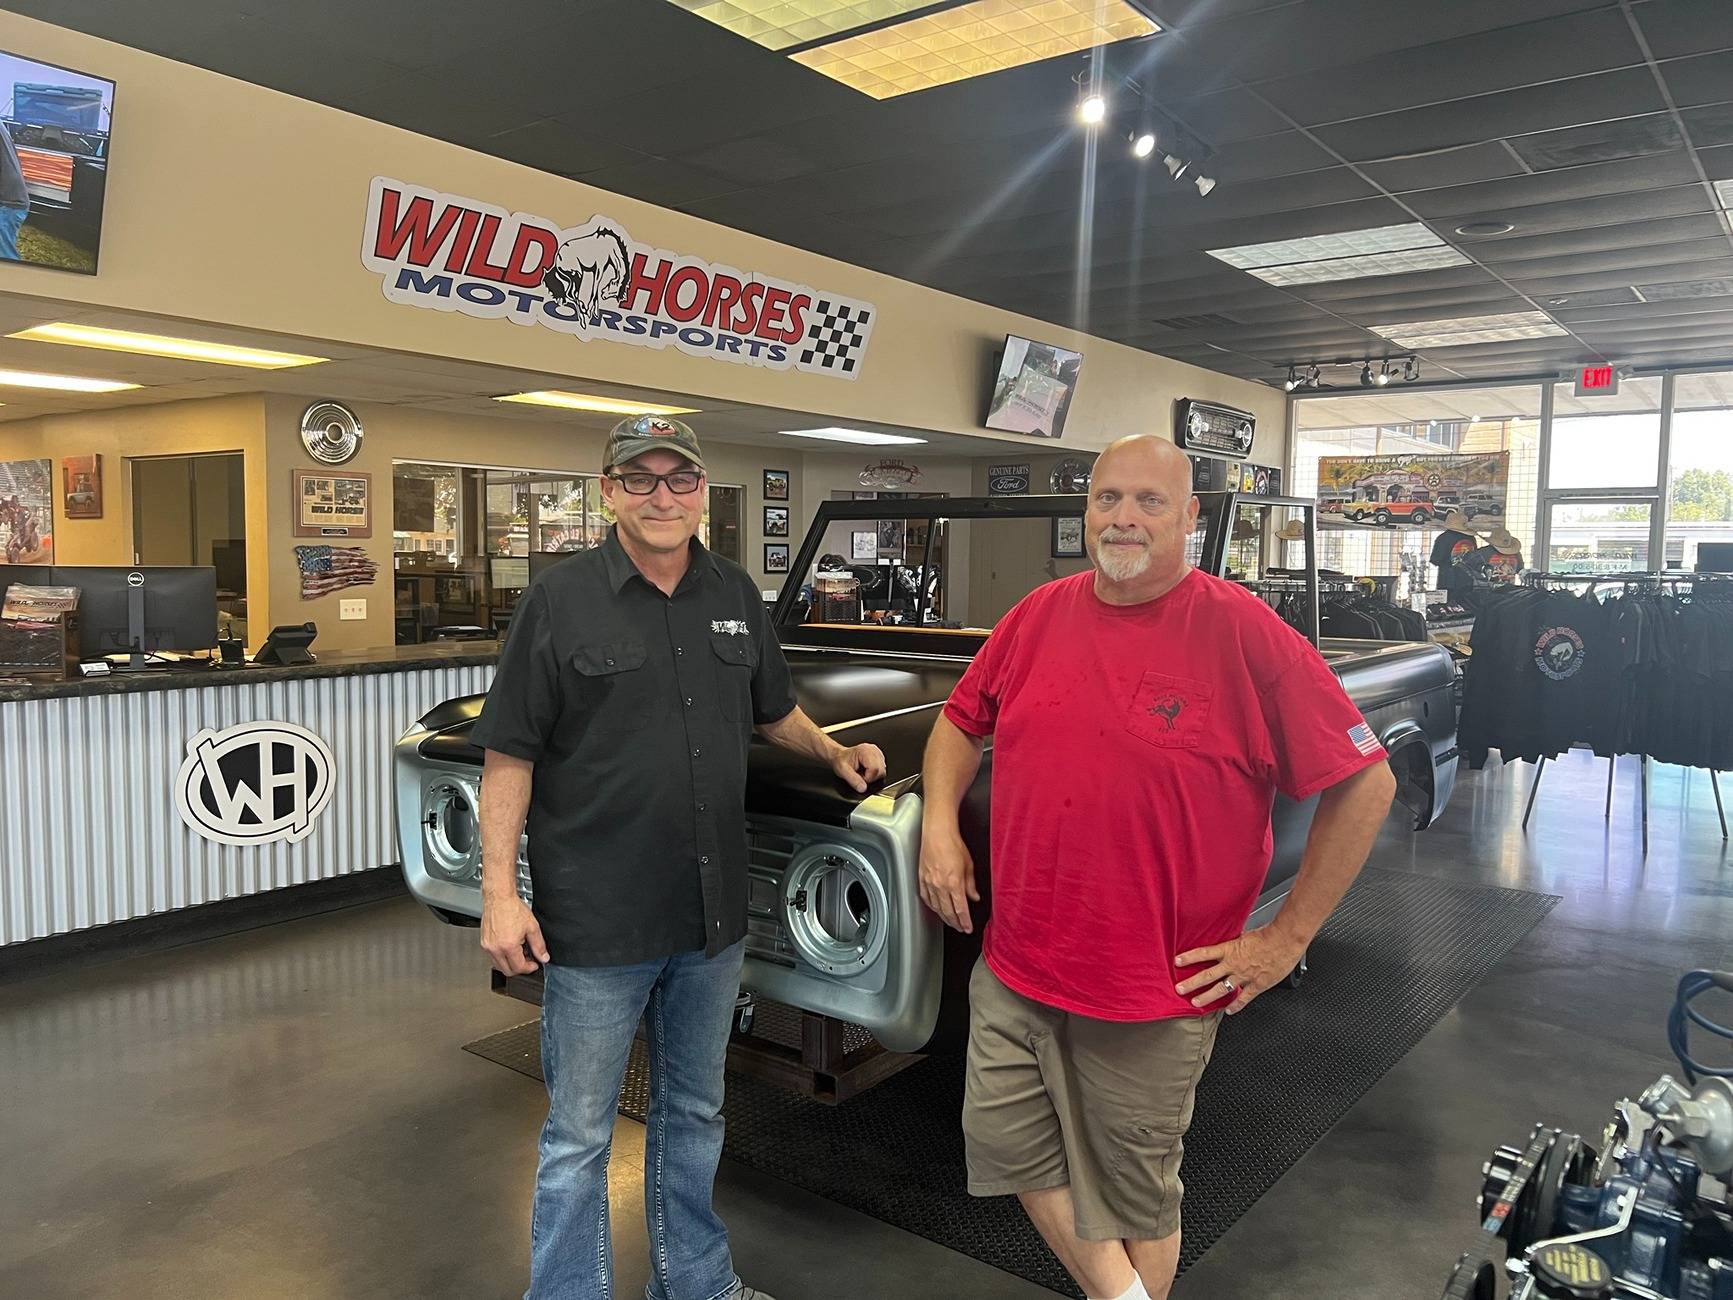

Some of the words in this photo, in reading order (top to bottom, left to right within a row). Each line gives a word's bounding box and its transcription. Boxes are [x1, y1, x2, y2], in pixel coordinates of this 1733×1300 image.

[374, 188, 558, 288] WILD
[624, 252, 812, 346] HORSES
[395, 268, 788, 363] MOTORSPORTS
[1583, 368, 1612, 389] EXIT
[990, 467, 1012, 476] GENUINE
[1012, 466, 1029, 475] PARTS
[997, 479, 1020, 490] Ford
